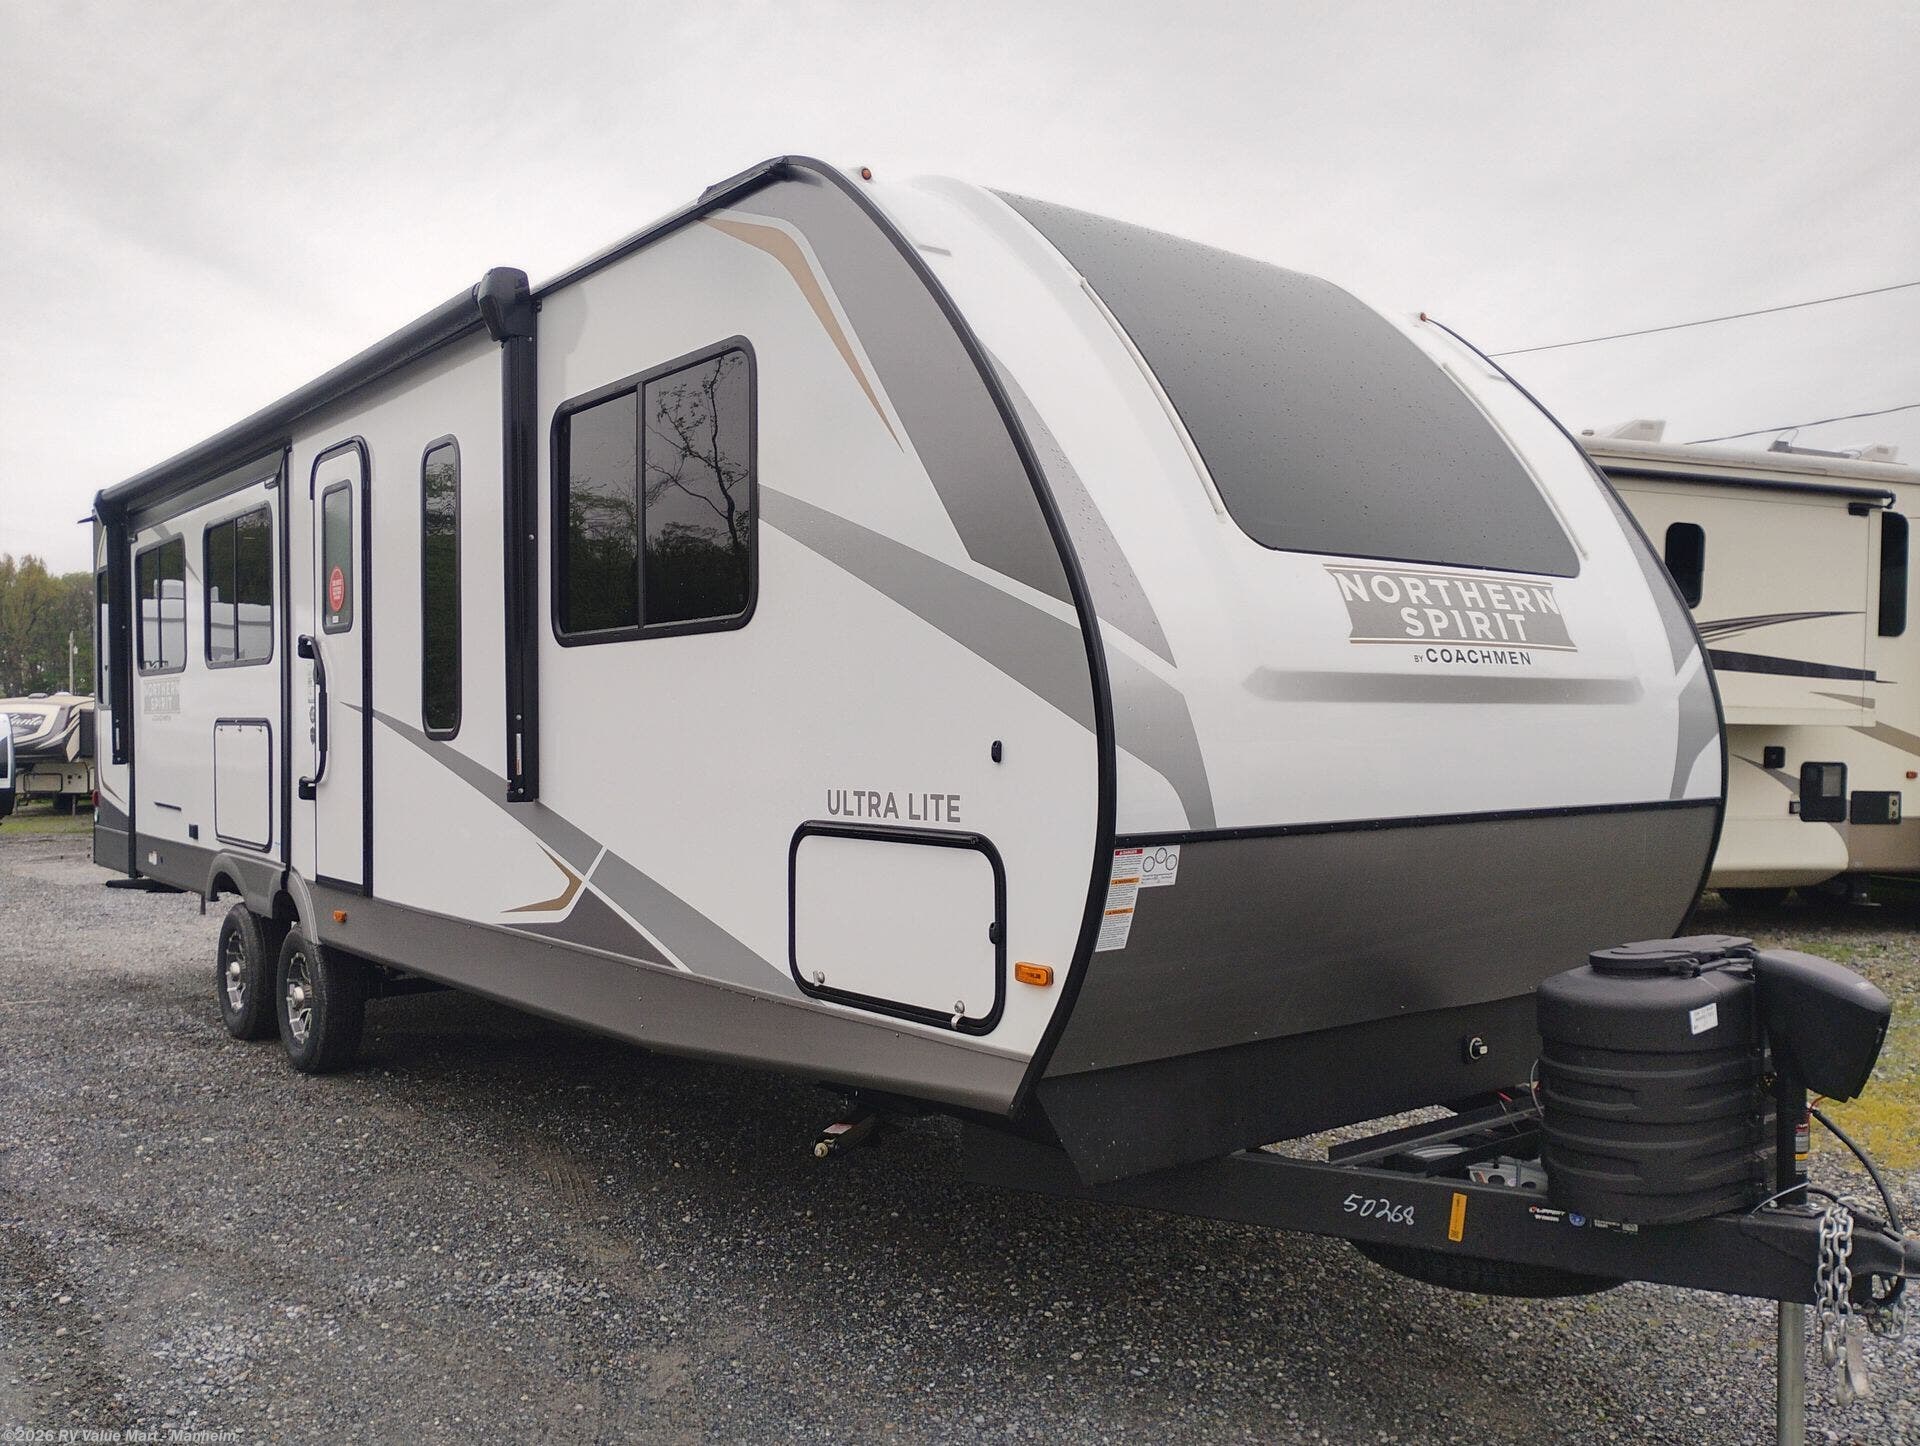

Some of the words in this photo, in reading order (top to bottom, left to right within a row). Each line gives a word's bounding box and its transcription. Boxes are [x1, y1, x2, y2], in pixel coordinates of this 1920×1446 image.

[1332, 572, 1560, 615] NORTHERN
[1400, 607, 1528, 642] SPIRIT
[1413, 654, 1424, 664] BY
[1425, 648, 1533, 666] COACHMEN
[827, 789, 899, 819] ULTRA
[908, 792, 961, 823] LITE
[1343, 1193, 1415, 1226] 50268
